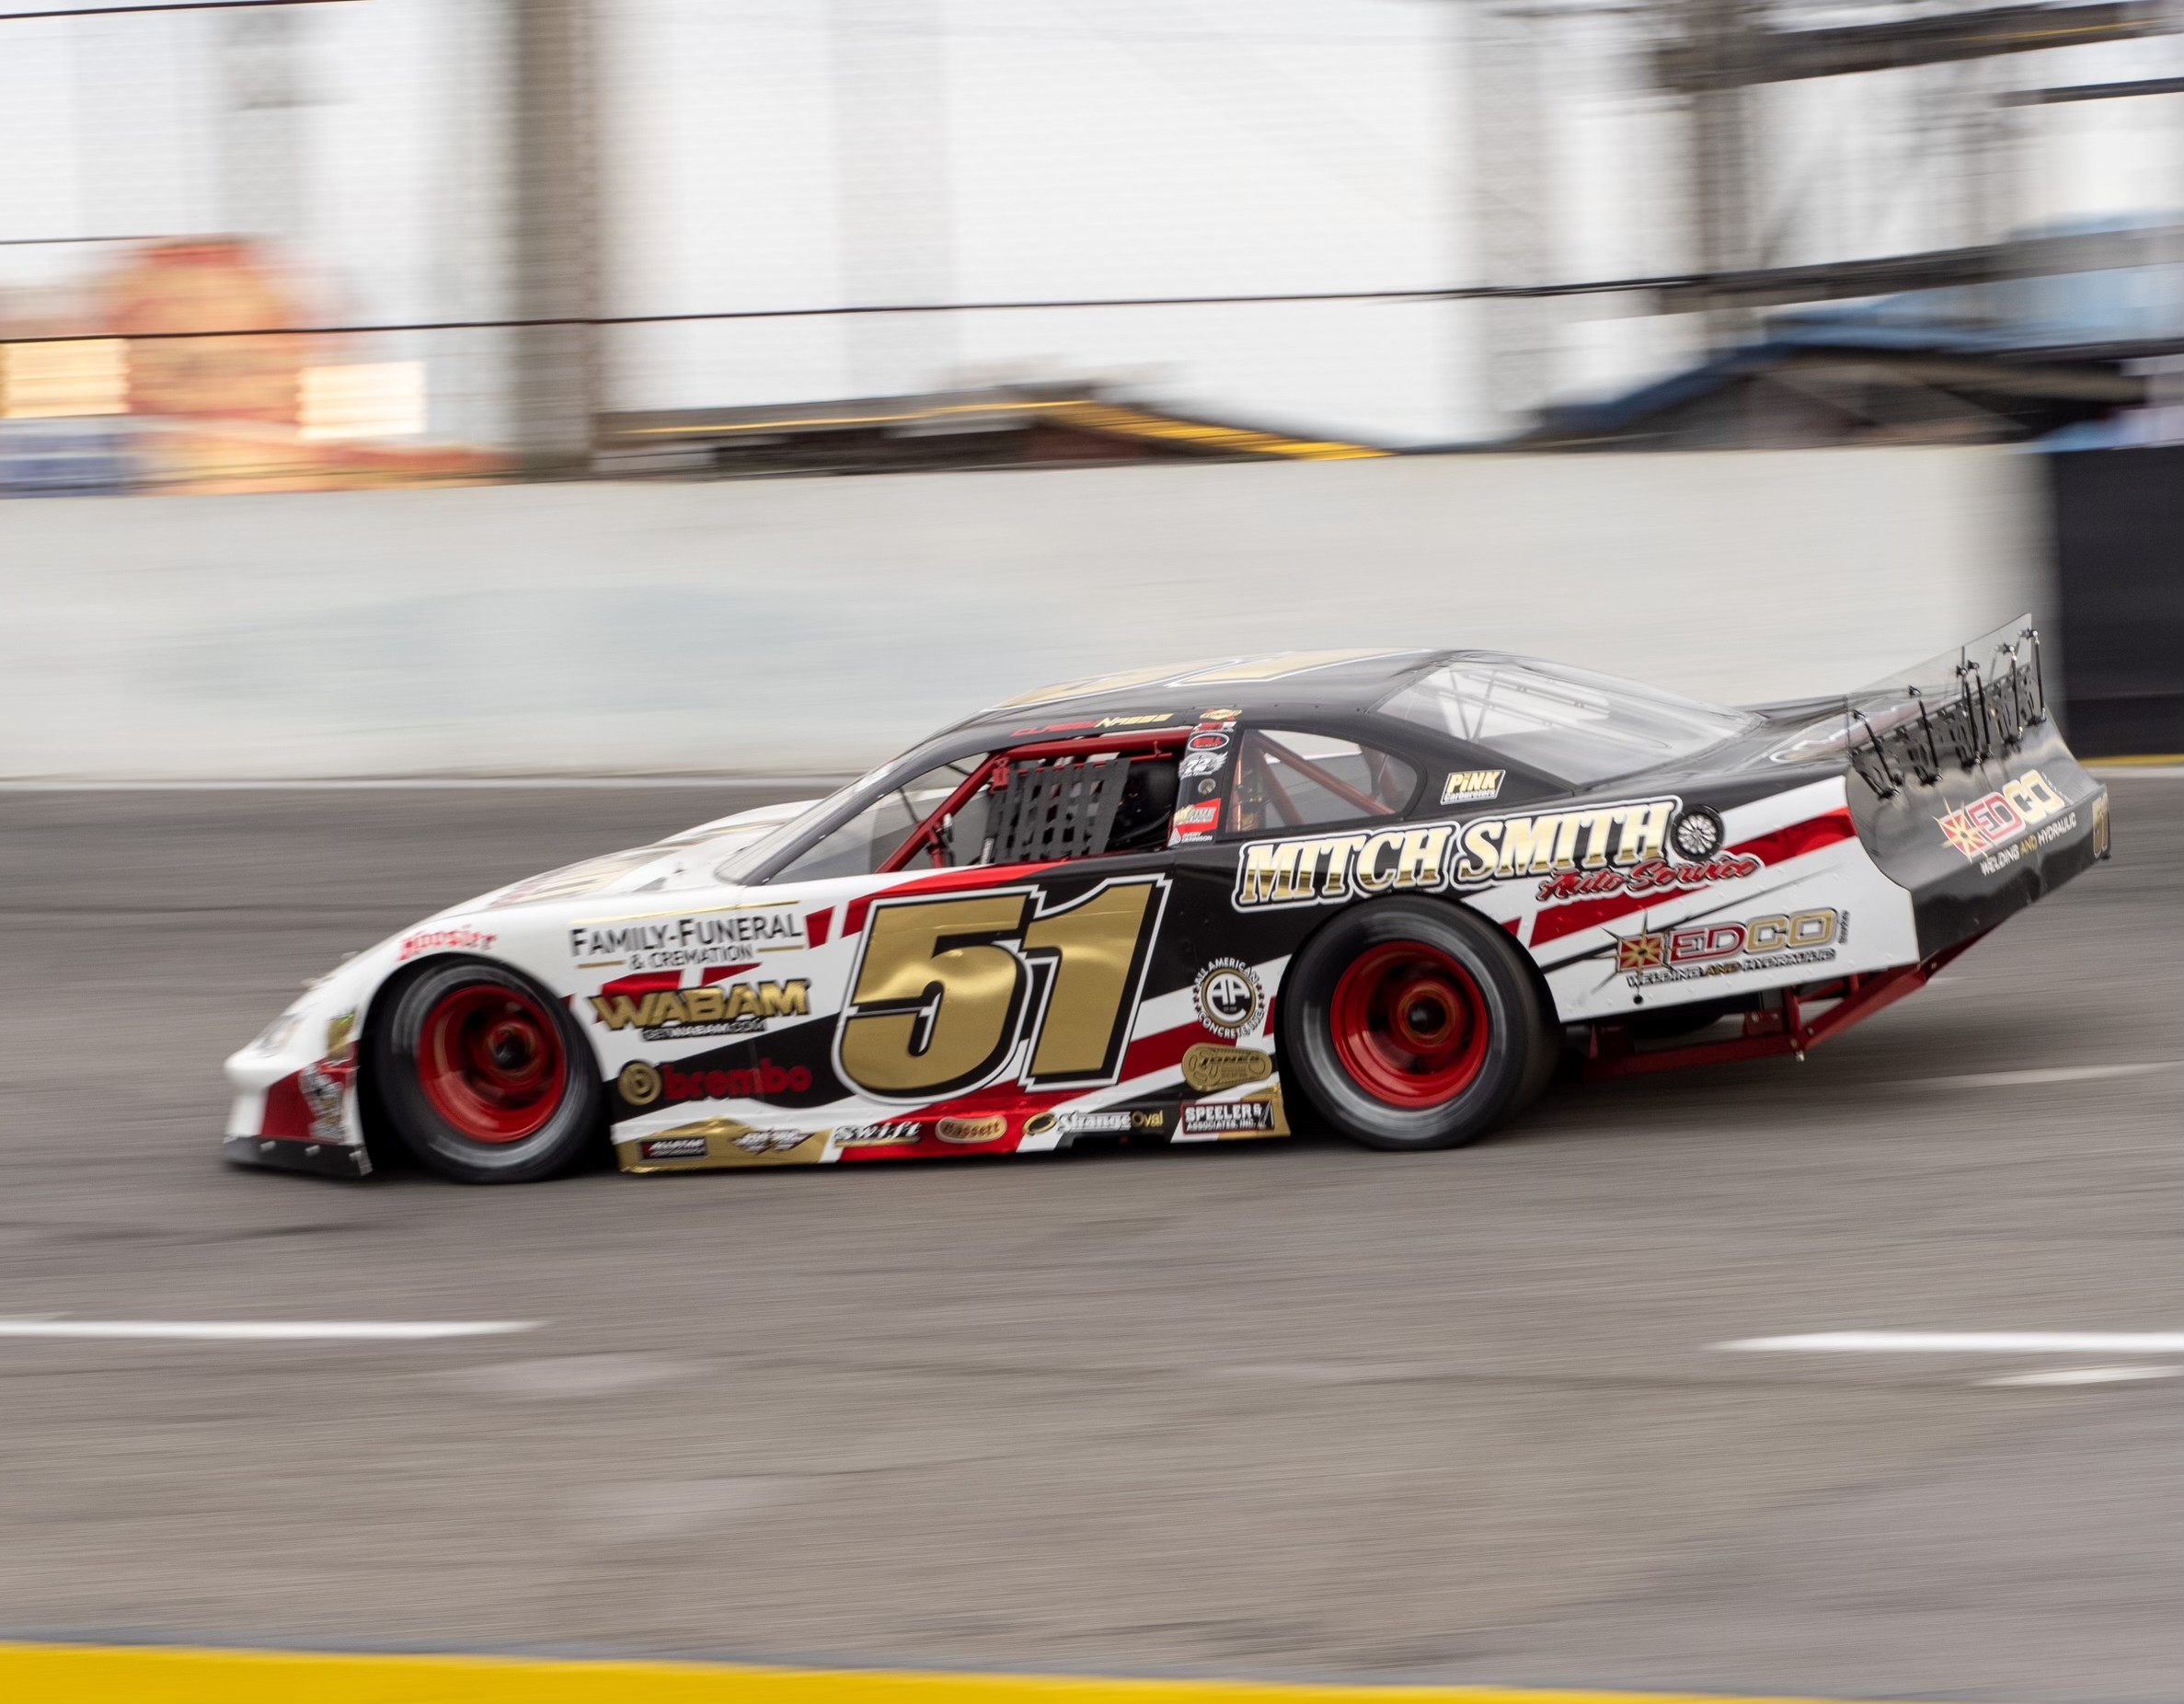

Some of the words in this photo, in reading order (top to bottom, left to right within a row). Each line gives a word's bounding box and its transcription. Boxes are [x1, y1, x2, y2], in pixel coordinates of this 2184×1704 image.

[1965, 769, 2065, 845] EDCO
[1238, 824, 1455, 906] MITCH
[1456, 799, 1677, 883] SMITH
[1980, 844, 2020, 876] WELDING
[2019, 834, 2037, 856] AND
[1535, 868, 1626, 901] Auto
[1626, 857, 1759, 892] Service
[630, 954, 645, 970] &
[648, 942, 753, 969] CREMATION
[1666, 906, 1838, 966] EDCO
[832, 874, 1172, 1104] 51
[1194, 967, 1209, 986] ALL
[1208, 957, 1261, 984] AMERICAN
[1627, 967, 1702, 988] WELDING
[1702, 961, 1741, 977] AND
[587, 977, 811, 1030] WABAM
[661, 1057, 812, 1100] brembo
[943, 1120, 1001, 1138] Bassett
[1058, 1109, 1132, 1132] Strange
[1132, 1111, 1164, 1128] Oval
[1185, 1103, 1252, 1123] SPEELER
